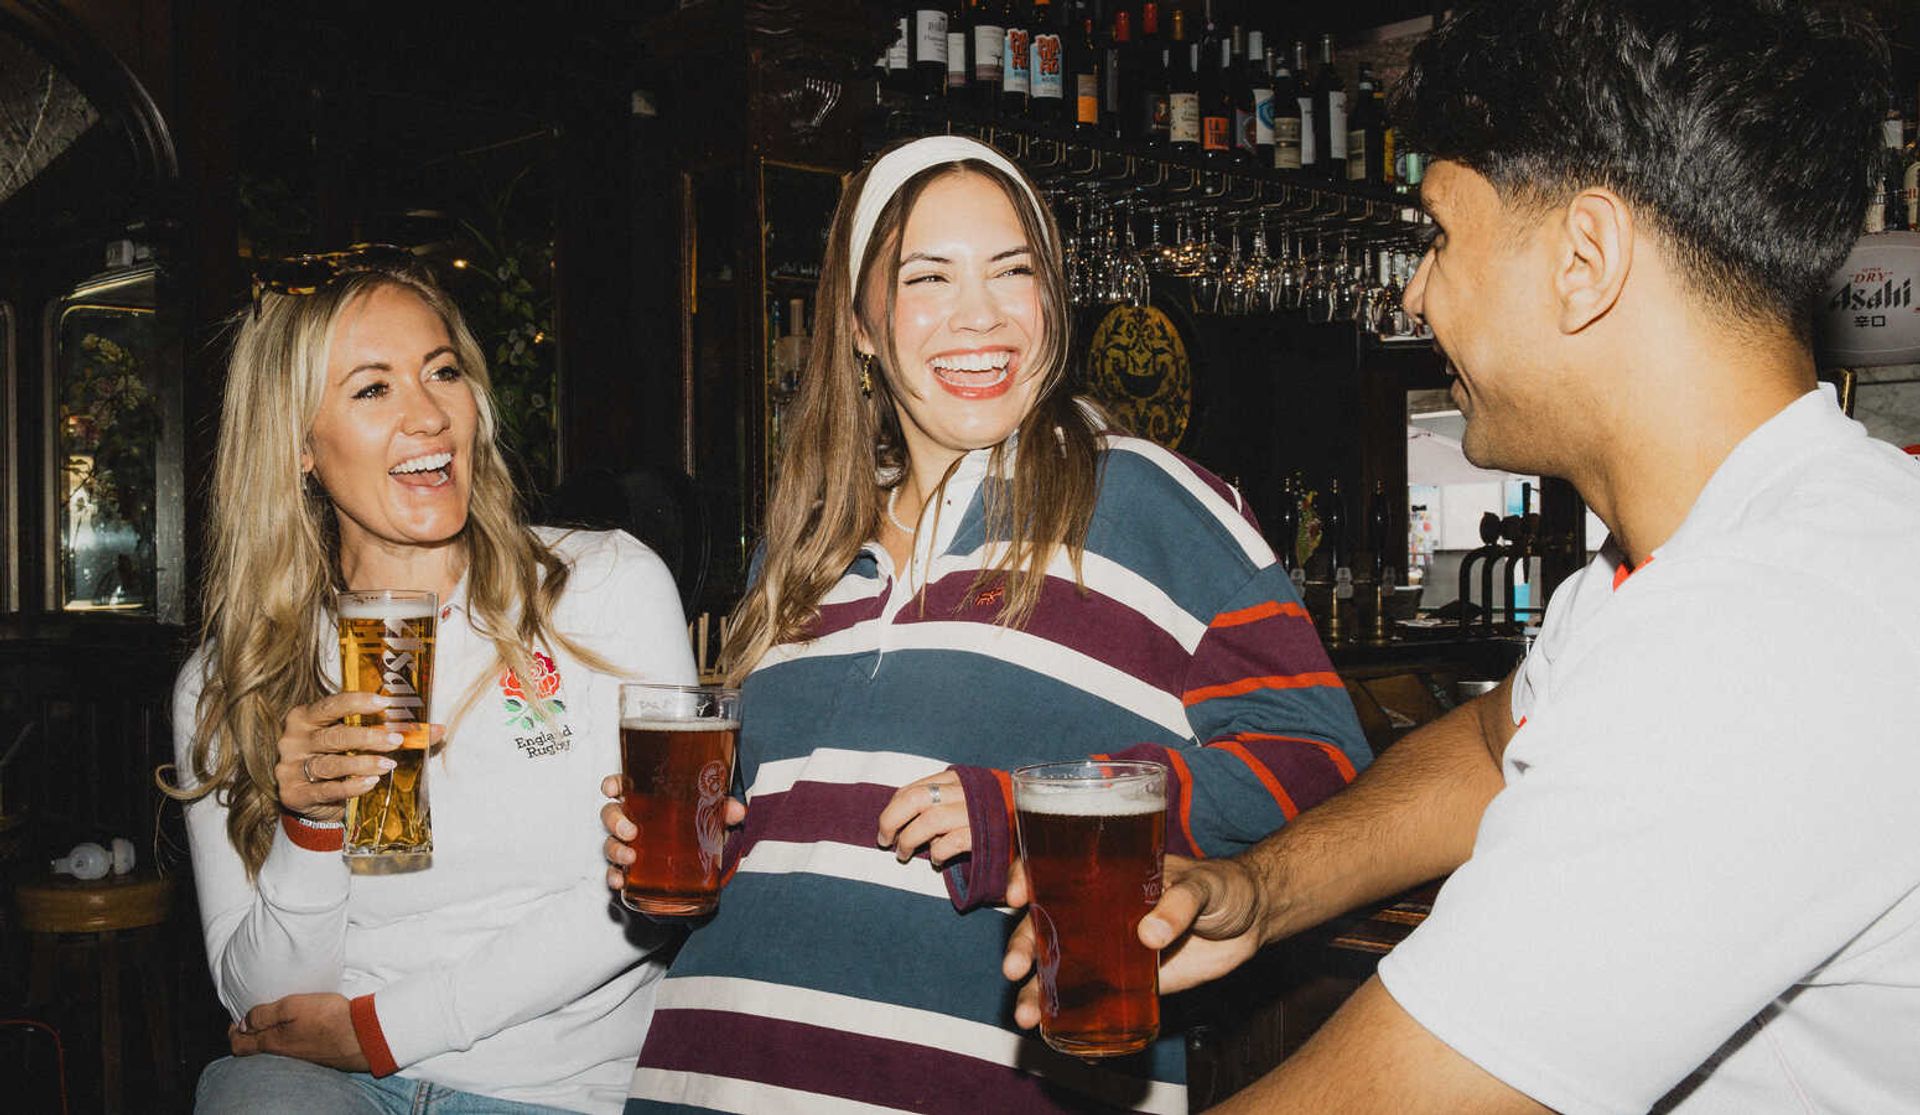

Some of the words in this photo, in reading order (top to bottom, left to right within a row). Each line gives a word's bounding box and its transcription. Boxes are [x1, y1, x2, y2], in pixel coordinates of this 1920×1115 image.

[1854, 271, 1886, 284] DRY
[1830, 278, 1911, 312] Asahi
[1854, 315, 1886, 328] 辛口
[515, 724, 573, 750] Englad
